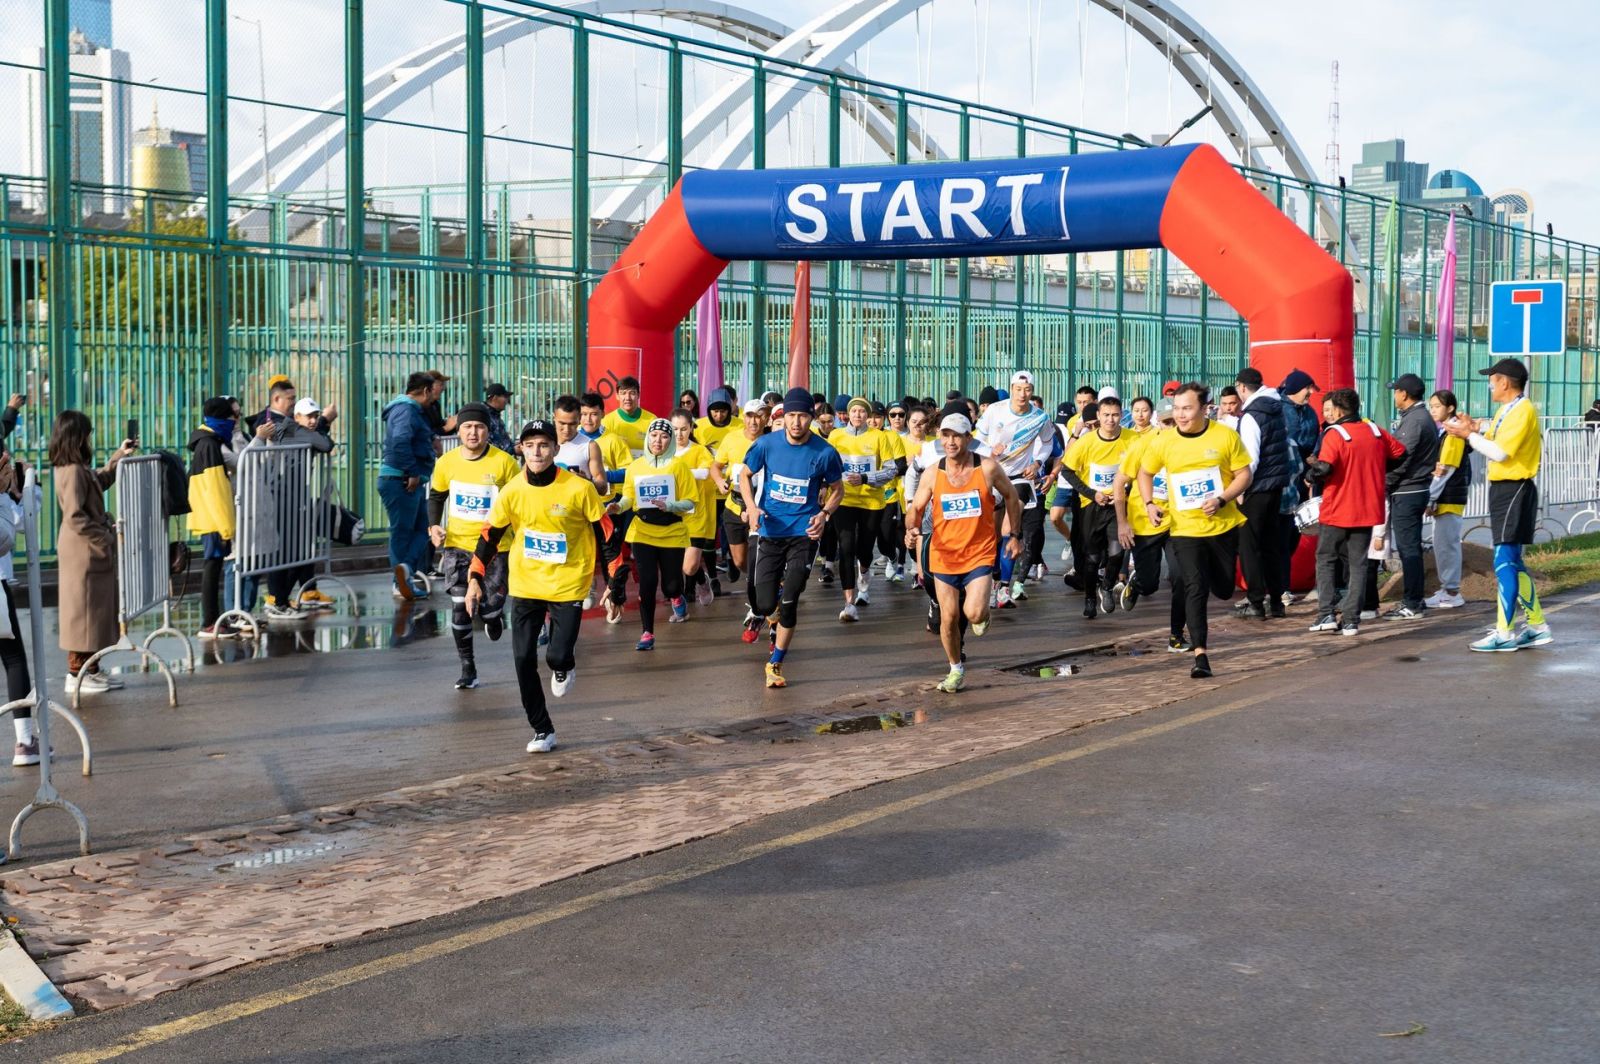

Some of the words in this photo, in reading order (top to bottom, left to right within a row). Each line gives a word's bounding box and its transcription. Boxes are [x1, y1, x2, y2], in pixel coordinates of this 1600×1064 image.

[785, 173, 1044, 243] START
[848, 464, 866, 473] 385
[1100, 473, 1116, 483] 35
[643, 486, 663, 496] 189
[777, 483, 801, 496] 154
[1184, 481, 1209, 497] 286
[460, 495, 485, 508] 282
[948, 498, 974, 511] 391
[532, 538, 559, 553] 153
